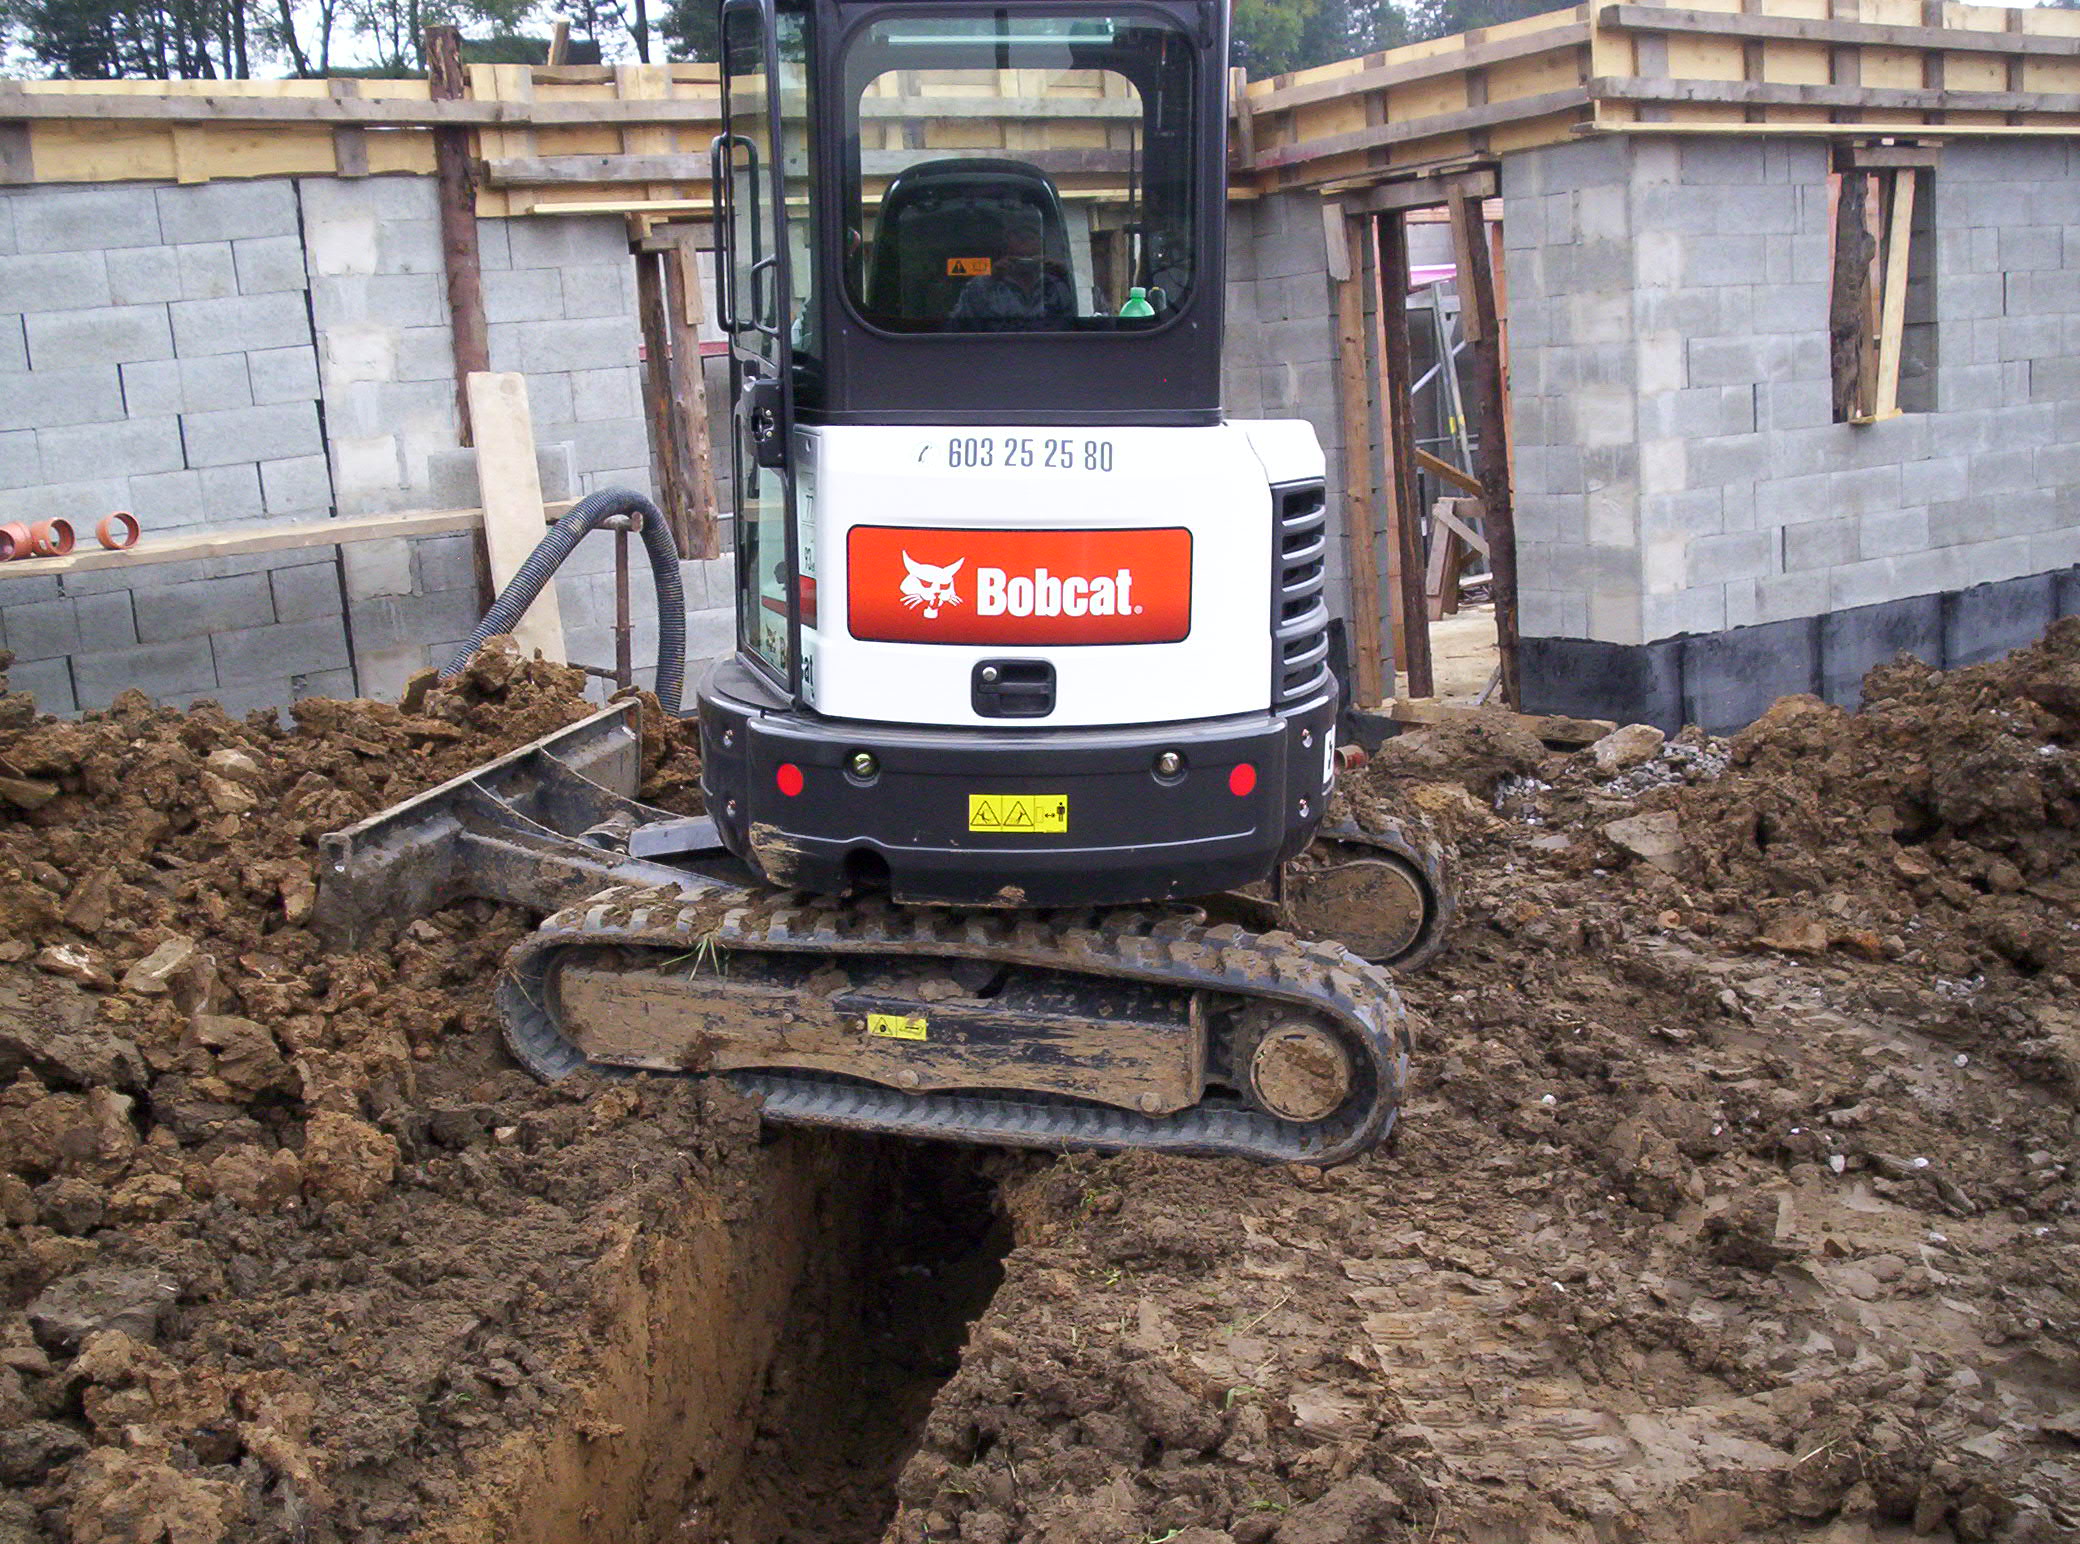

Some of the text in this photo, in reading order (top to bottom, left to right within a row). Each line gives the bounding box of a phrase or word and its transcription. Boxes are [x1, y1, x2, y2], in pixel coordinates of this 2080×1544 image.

[948, 437, 1113, 472] 603 25 25 80
[976, 567, 1133, 617] Bobcat
